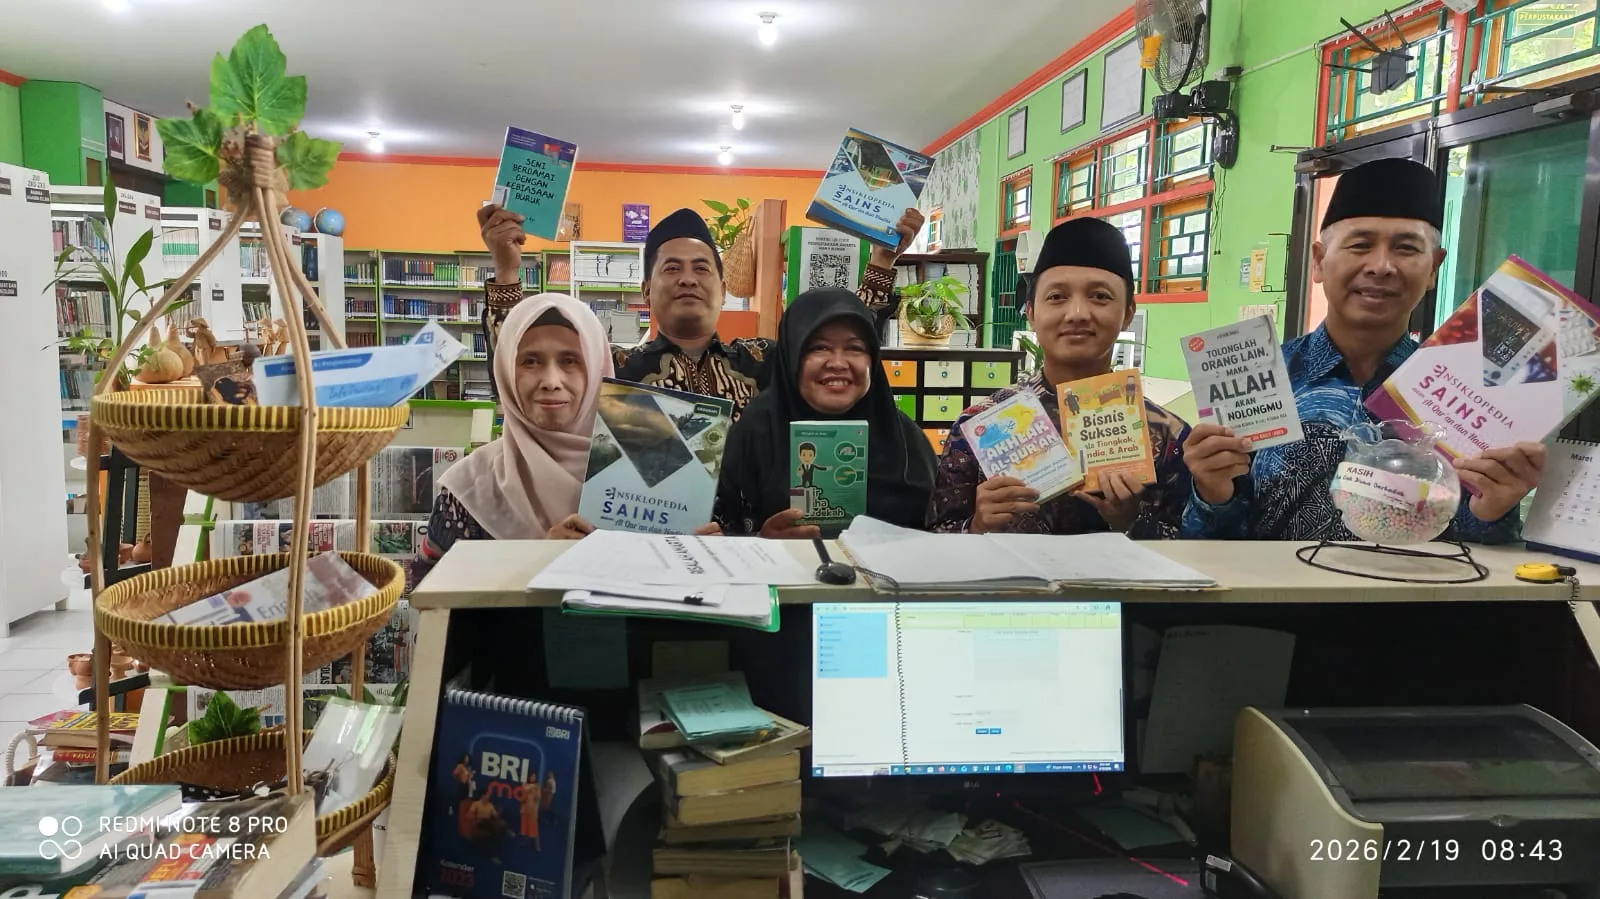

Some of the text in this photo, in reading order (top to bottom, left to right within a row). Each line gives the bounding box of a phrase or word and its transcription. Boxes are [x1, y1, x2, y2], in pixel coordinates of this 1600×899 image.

[512, 164, 556, 181] BERDAMAI
[525, 158, 547, 170] SENI
[515, 174, 549, 188] DENGAN
[506, 181, 554, 200] KEBIASAAN
[515, 193, 541, 206] BURUK
[834, 191, 881, 213] SAINS
[1207, 339, 1257, 359] TOLONGLAH
[1201, 354, 1238, 372] ORANG
[1226, 365, 1249, 377] MAKA
[1209, 369, 1276, 403] ALLAH
[1227, 401, 1283, 421] NOLONGMU
[1235, 397, 1256, 408] AKAN
[1419, 375, 1487, 429] SAINS
[1082, 410, 1124, 428] Bisnis
[986, 420, 1050, 460] AKHLAK
[1080, 424, 1127, 441] Sukses
[1086, 449, 1108, 459] ndia,
[1118, 444, 1138, 453] Arab
[1346, 467, 1374, 478] KASIH
[603, 501, 669, 524] SAINS
[481, 751, 530, 785] BRI
